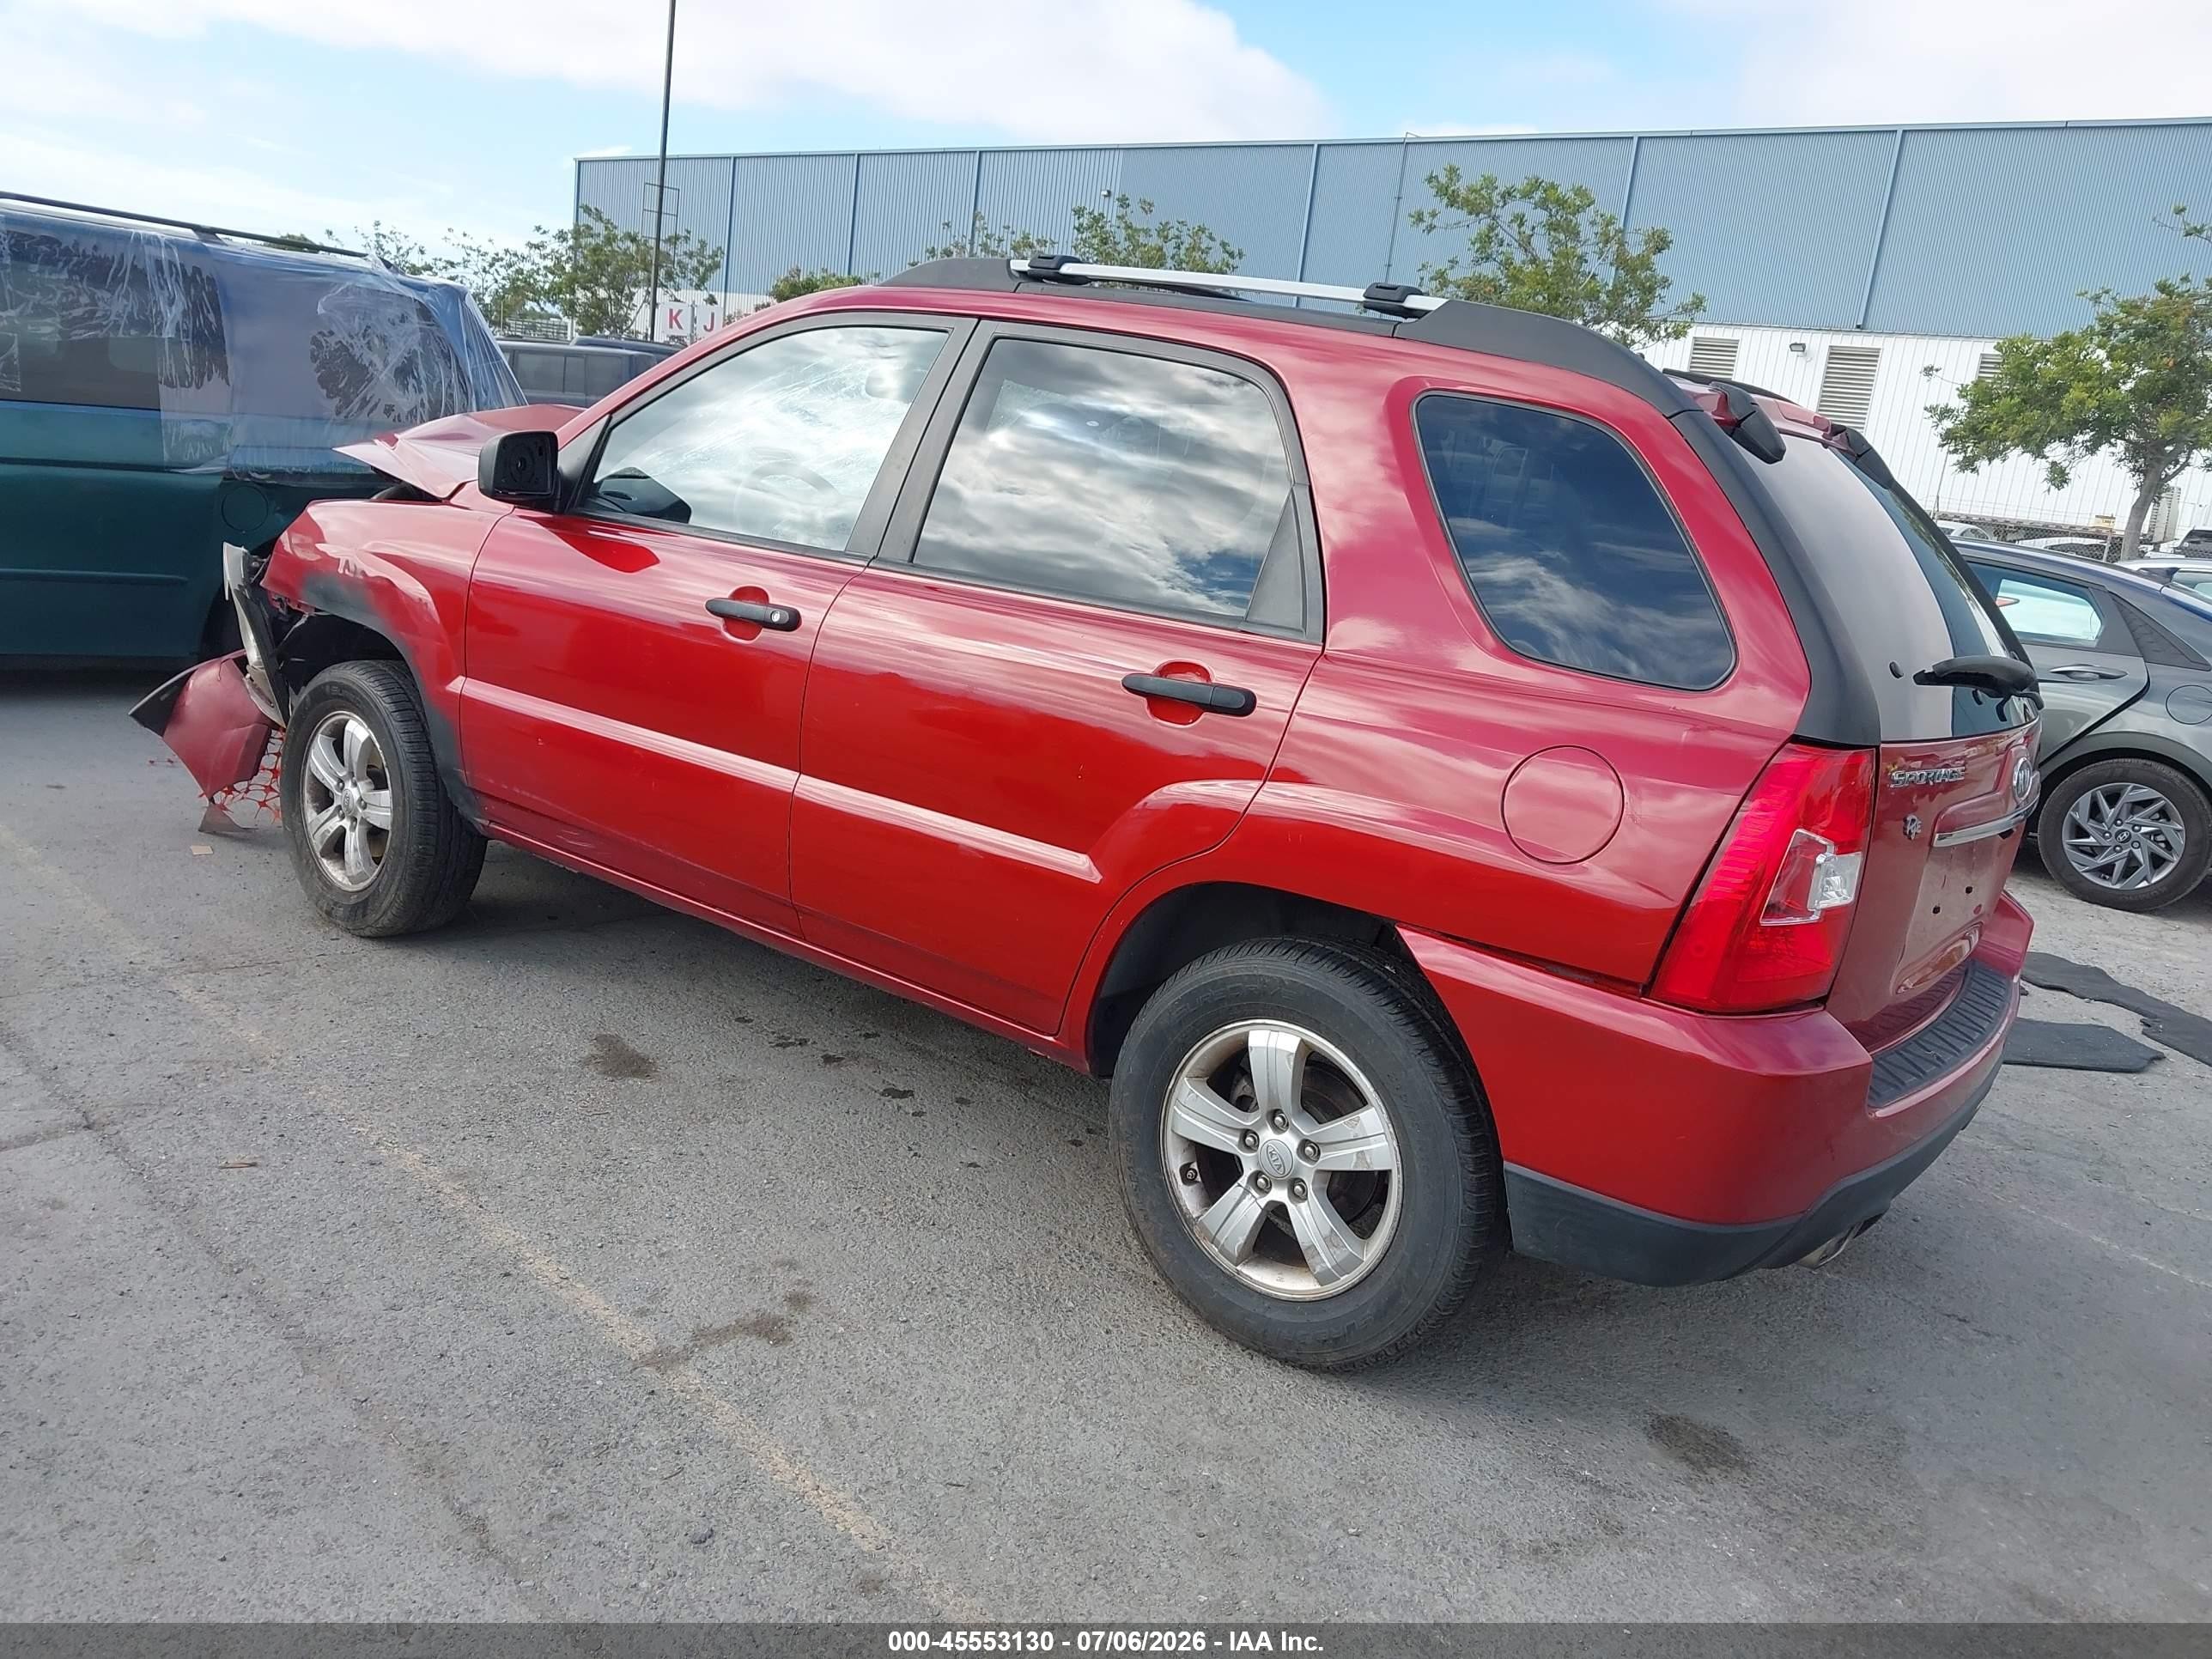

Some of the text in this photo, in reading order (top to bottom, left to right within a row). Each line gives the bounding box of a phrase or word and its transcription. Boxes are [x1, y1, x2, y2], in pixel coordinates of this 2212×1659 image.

[668, 308, 684, 331] K
[703, 312, 715, 332] J
[1890, 766, 1966, 788] SPORTAGE
[1268, 1147, 1283, 1171] KIA
